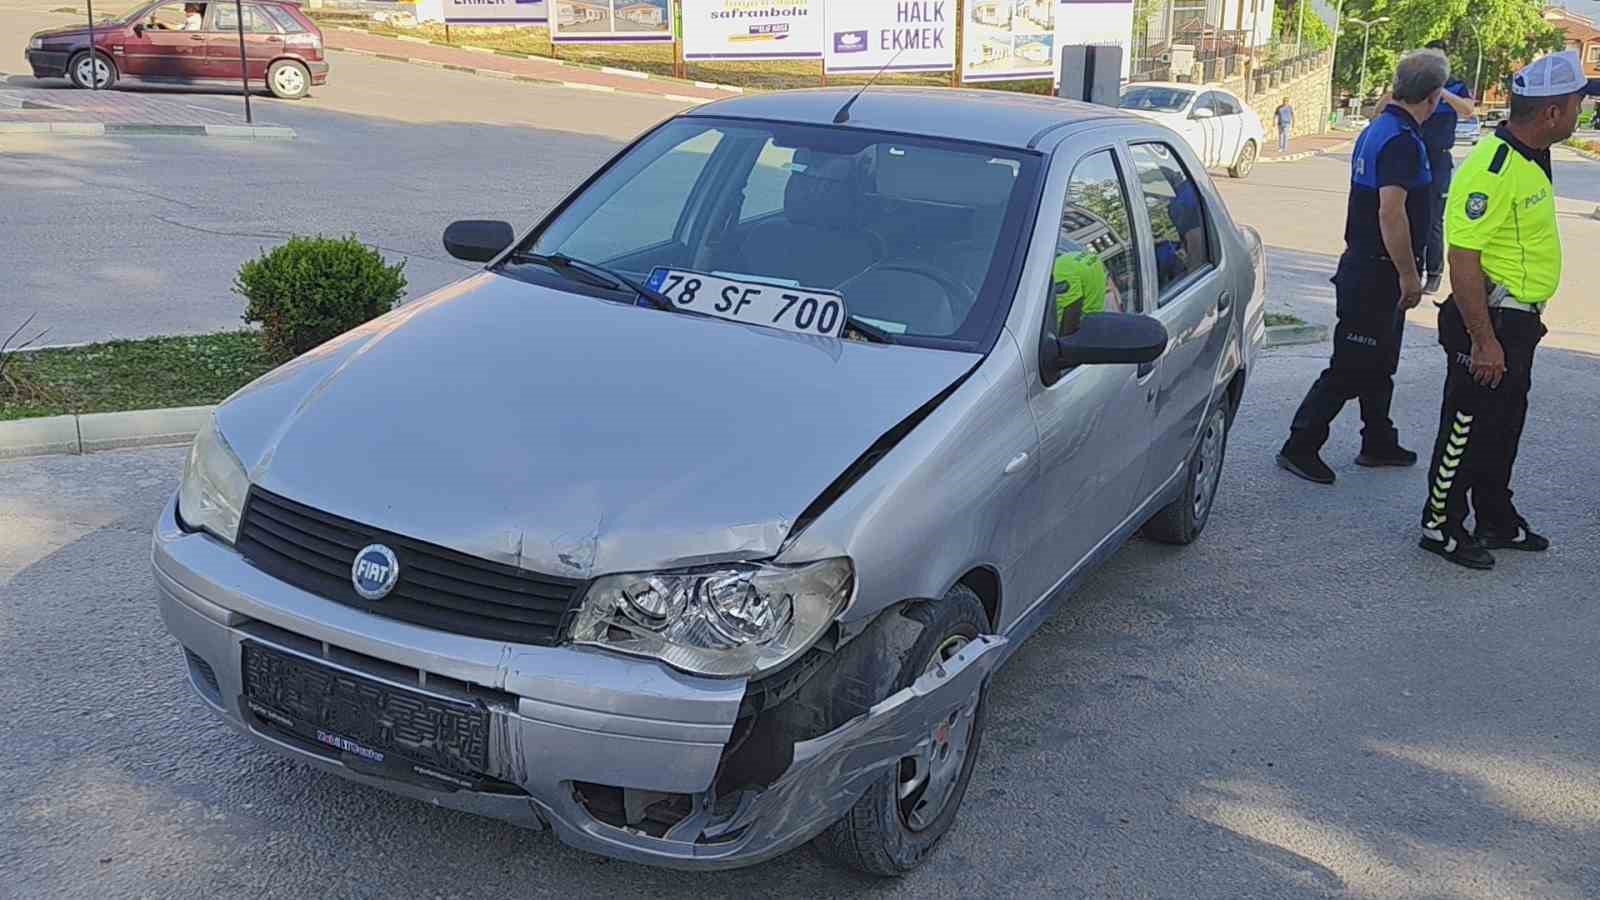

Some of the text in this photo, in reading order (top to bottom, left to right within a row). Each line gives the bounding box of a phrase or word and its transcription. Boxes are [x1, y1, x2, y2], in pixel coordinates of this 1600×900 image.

[710, 6, 808, 19] safranbolu
[897, 0, 944, 22] HALK
[881, 28, 944, 50] EKMEK
[662, 275, 840, 334] 78 SF 700
[357, 559, 389, 583] FIAT
